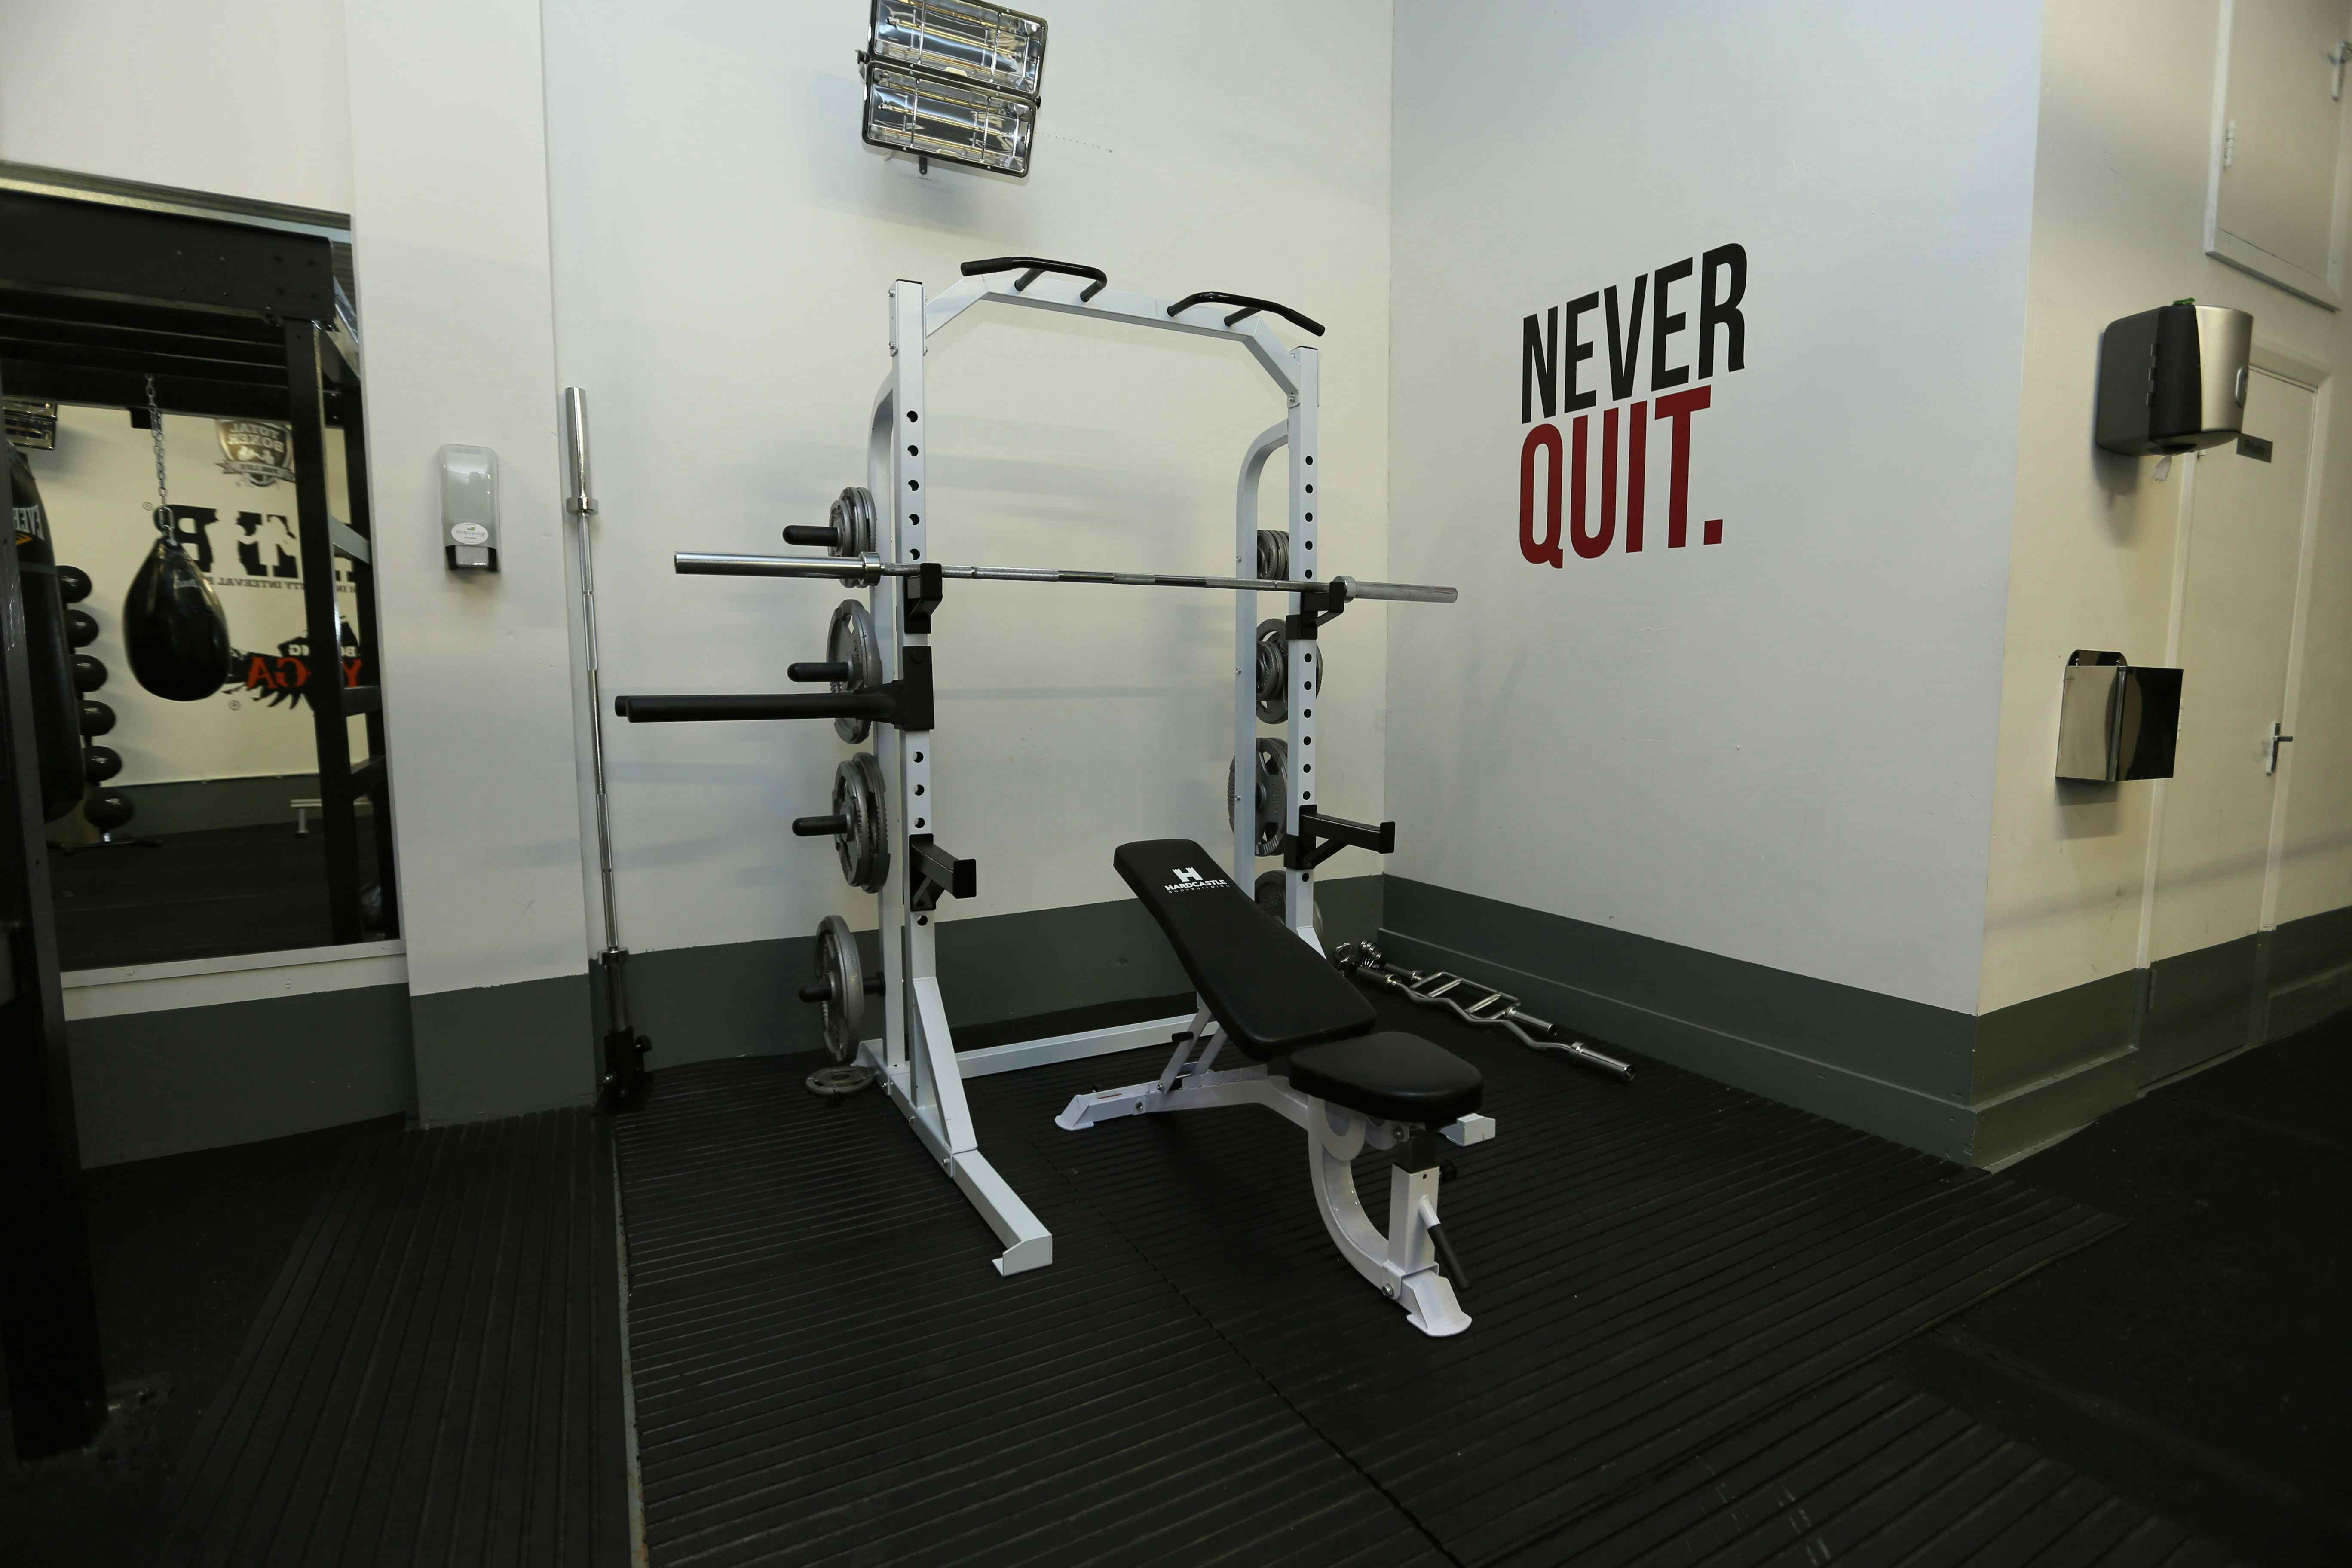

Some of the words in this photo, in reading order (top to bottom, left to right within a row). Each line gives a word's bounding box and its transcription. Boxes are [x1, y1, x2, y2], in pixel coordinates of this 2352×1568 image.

[1522, 243, 1747, 424] NEVER
[1519, 384, 1724, 569] QUIT.
[1164, 879, 1228, 891] HARDCASTLE
[1168, 884, 1231, 894] BODYBUILDING
